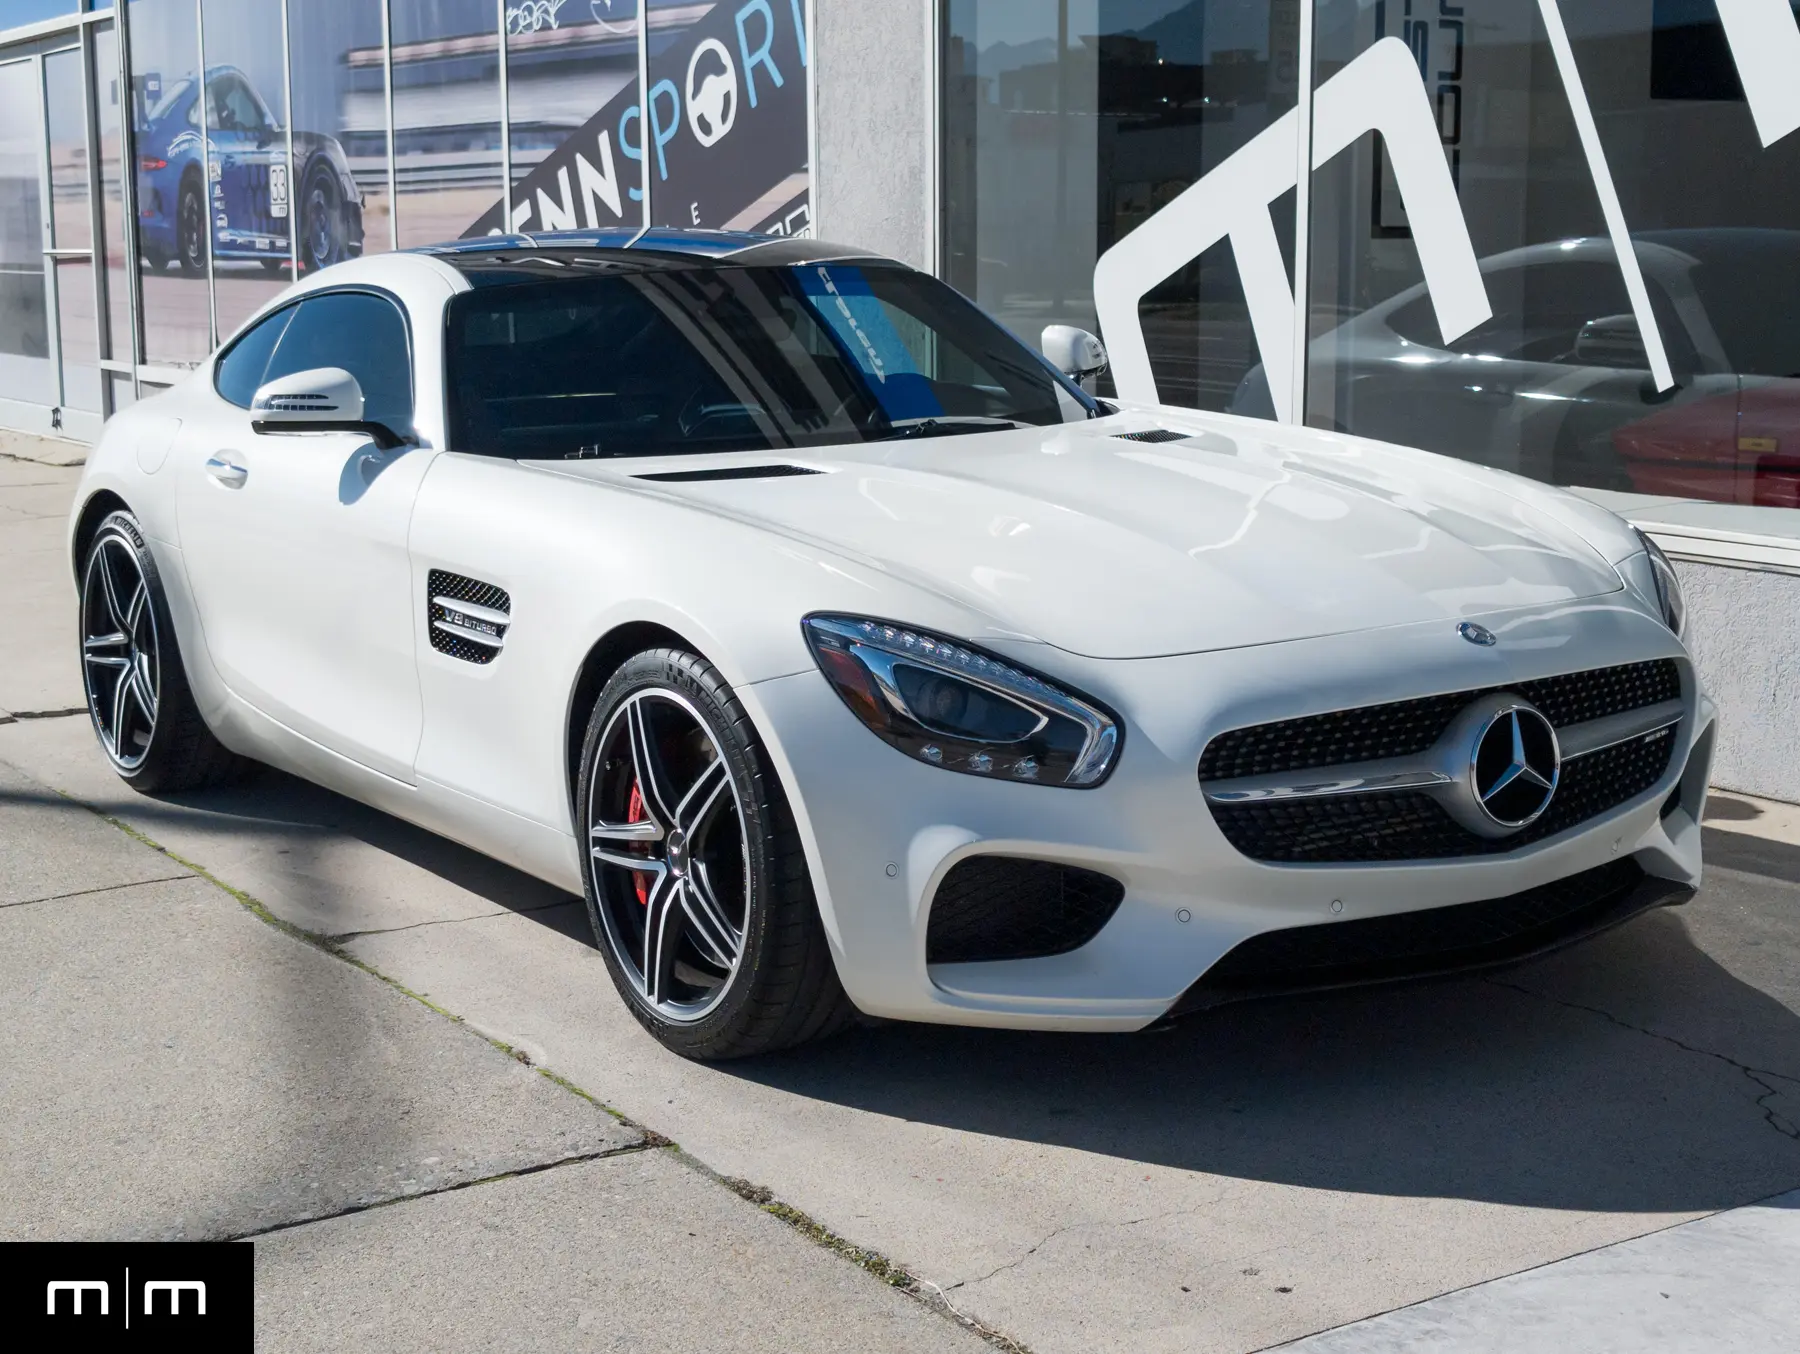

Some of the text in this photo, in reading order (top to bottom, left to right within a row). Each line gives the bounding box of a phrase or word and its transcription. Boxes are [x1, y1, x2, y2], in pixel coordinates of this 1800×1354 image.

[271, 168, 287, 202] 33
[444, 609, 497, 636] V8 BITURBO
